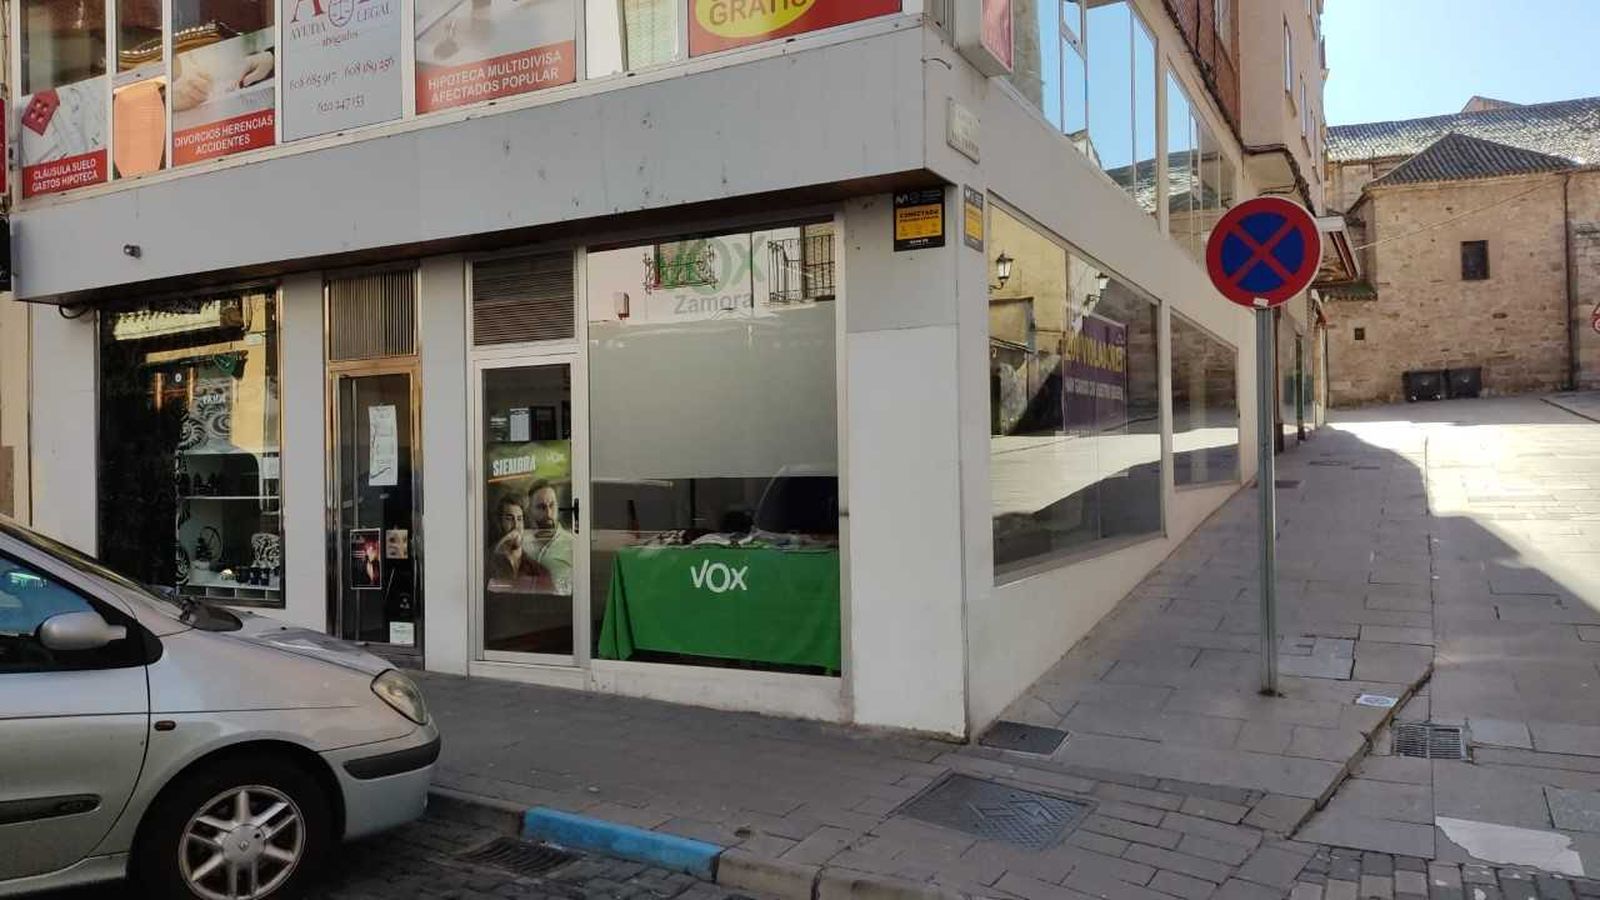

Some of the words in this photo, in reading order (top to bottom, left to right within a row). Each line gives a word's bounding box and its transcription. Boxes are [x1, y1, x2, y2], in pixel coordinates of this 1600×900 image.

[428, 67, 485, 90] HIPOTECA
[487, 51, 562, 77] MULTIDIVISA
[431, 80, 499, 103] AFECTADOS
[502, 66, 560, 88] POPULAR
[174, 128, 222, 148] DIVORCIOS
[221, 115, 275, 138] HERENCIAS
[195, 133, 252, 155] ACCIDENTES
[71, 159, 97, 171] SUELO
[31, 178, 62, 192] GASTOS
[60, 171, 99, 187] HIPOTECA
[672, 291, 752, 316] Zamora
[493, 455, 536, 476] SIEMBRA
[690, 559, 749, 594] VOX
